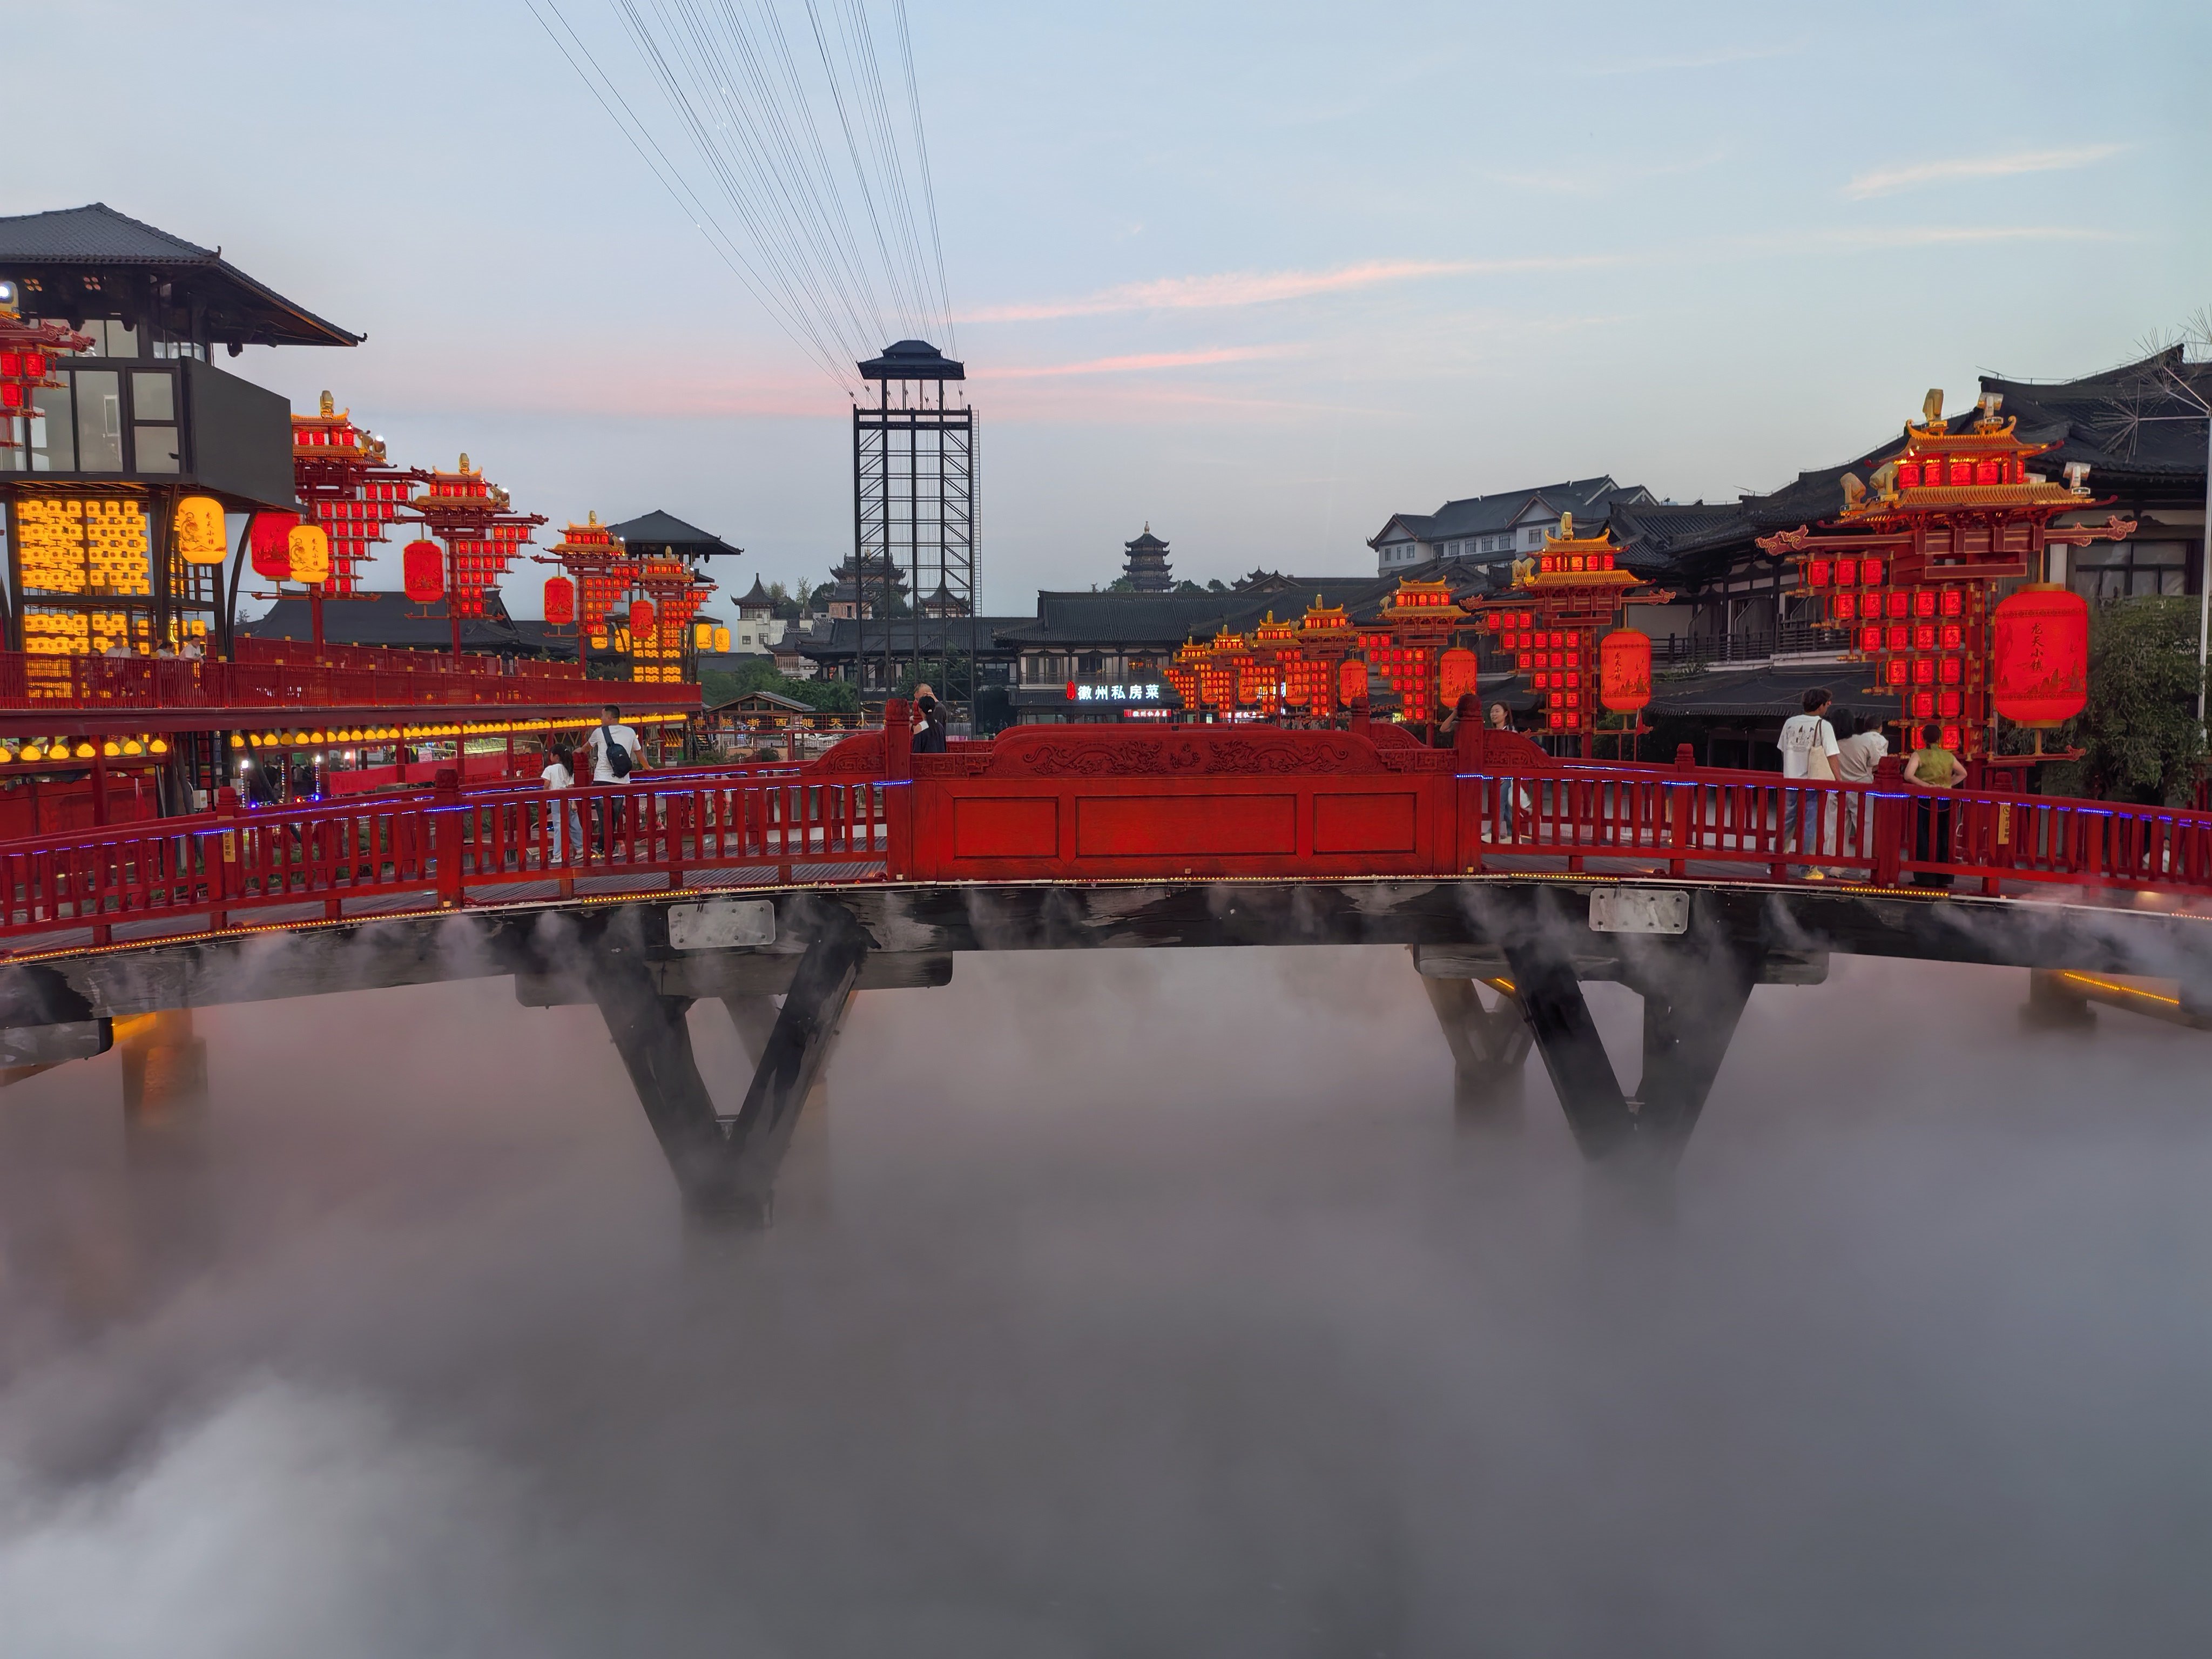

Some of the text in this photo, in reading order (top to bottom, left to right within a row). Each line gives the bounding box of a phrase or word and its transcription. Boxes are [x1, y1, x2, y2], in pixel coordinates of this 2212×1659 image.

[2031, 623, 2044, 671] 龙天小镇
[1078, 684, 1159, 700] 徽州私房菜
